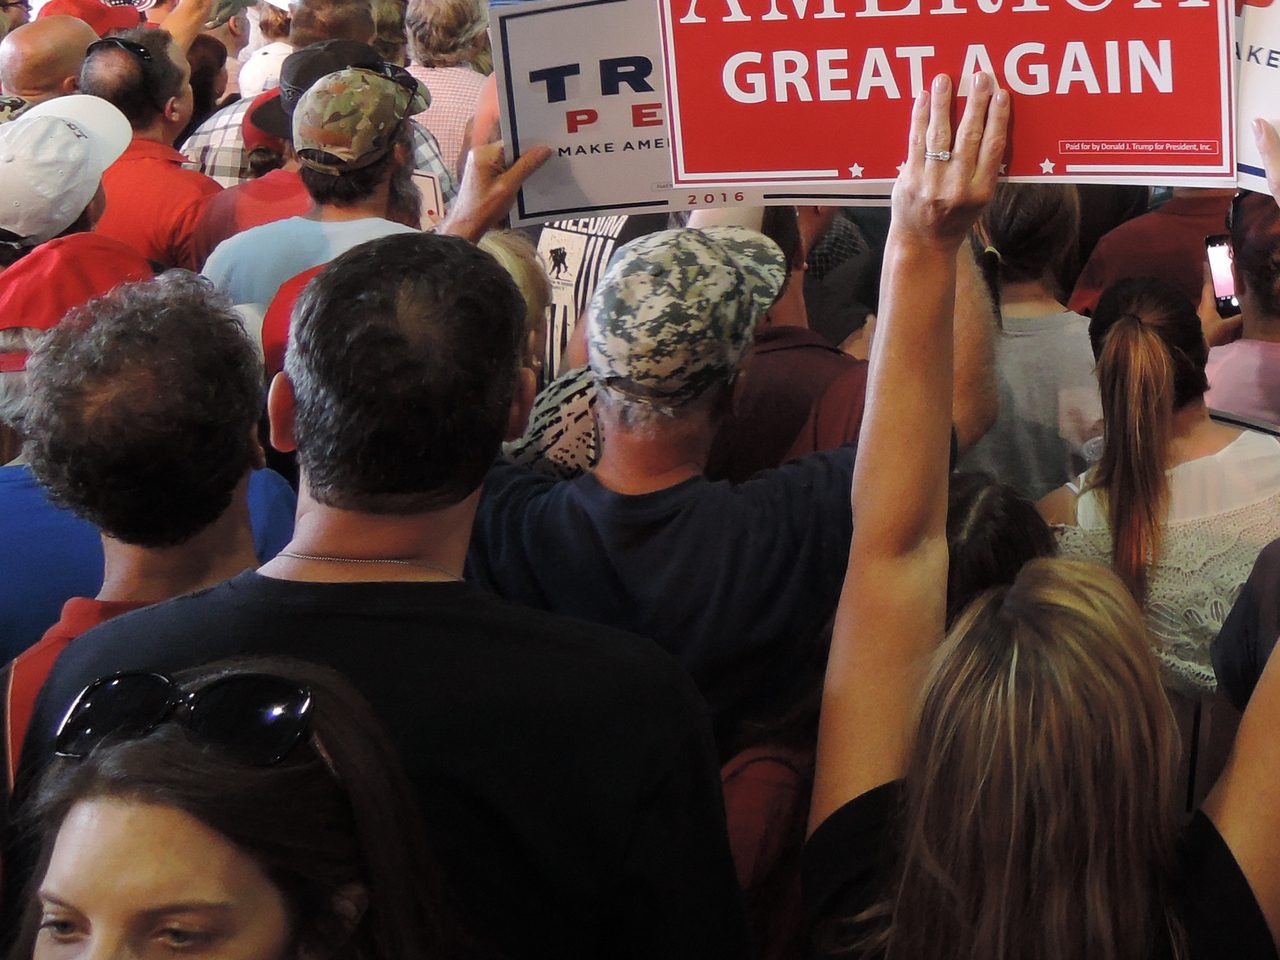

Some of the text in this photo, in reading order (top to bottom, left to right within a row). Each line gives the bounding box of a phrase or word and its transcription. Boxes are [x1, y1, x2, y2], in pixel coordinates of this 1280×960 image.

[722, 39, 1174, 104] GREAT AGAIN
[557, 137, 670, 157] MAKE AME
[1065, 143, 1080, 151] Paid
[1081, 143, 1091, 151] for
[1092, 143, 1101, 152] by
[1101, 143, 1125, 151] Donald
[1133, 143, 1154, 152] Trump
[1155, 143, 1164, 151] for
[1166, 143, 1199, 152] President,
[1199, 143, 1213, 151] Inc.
[687, 191, 745, 205] 2016
